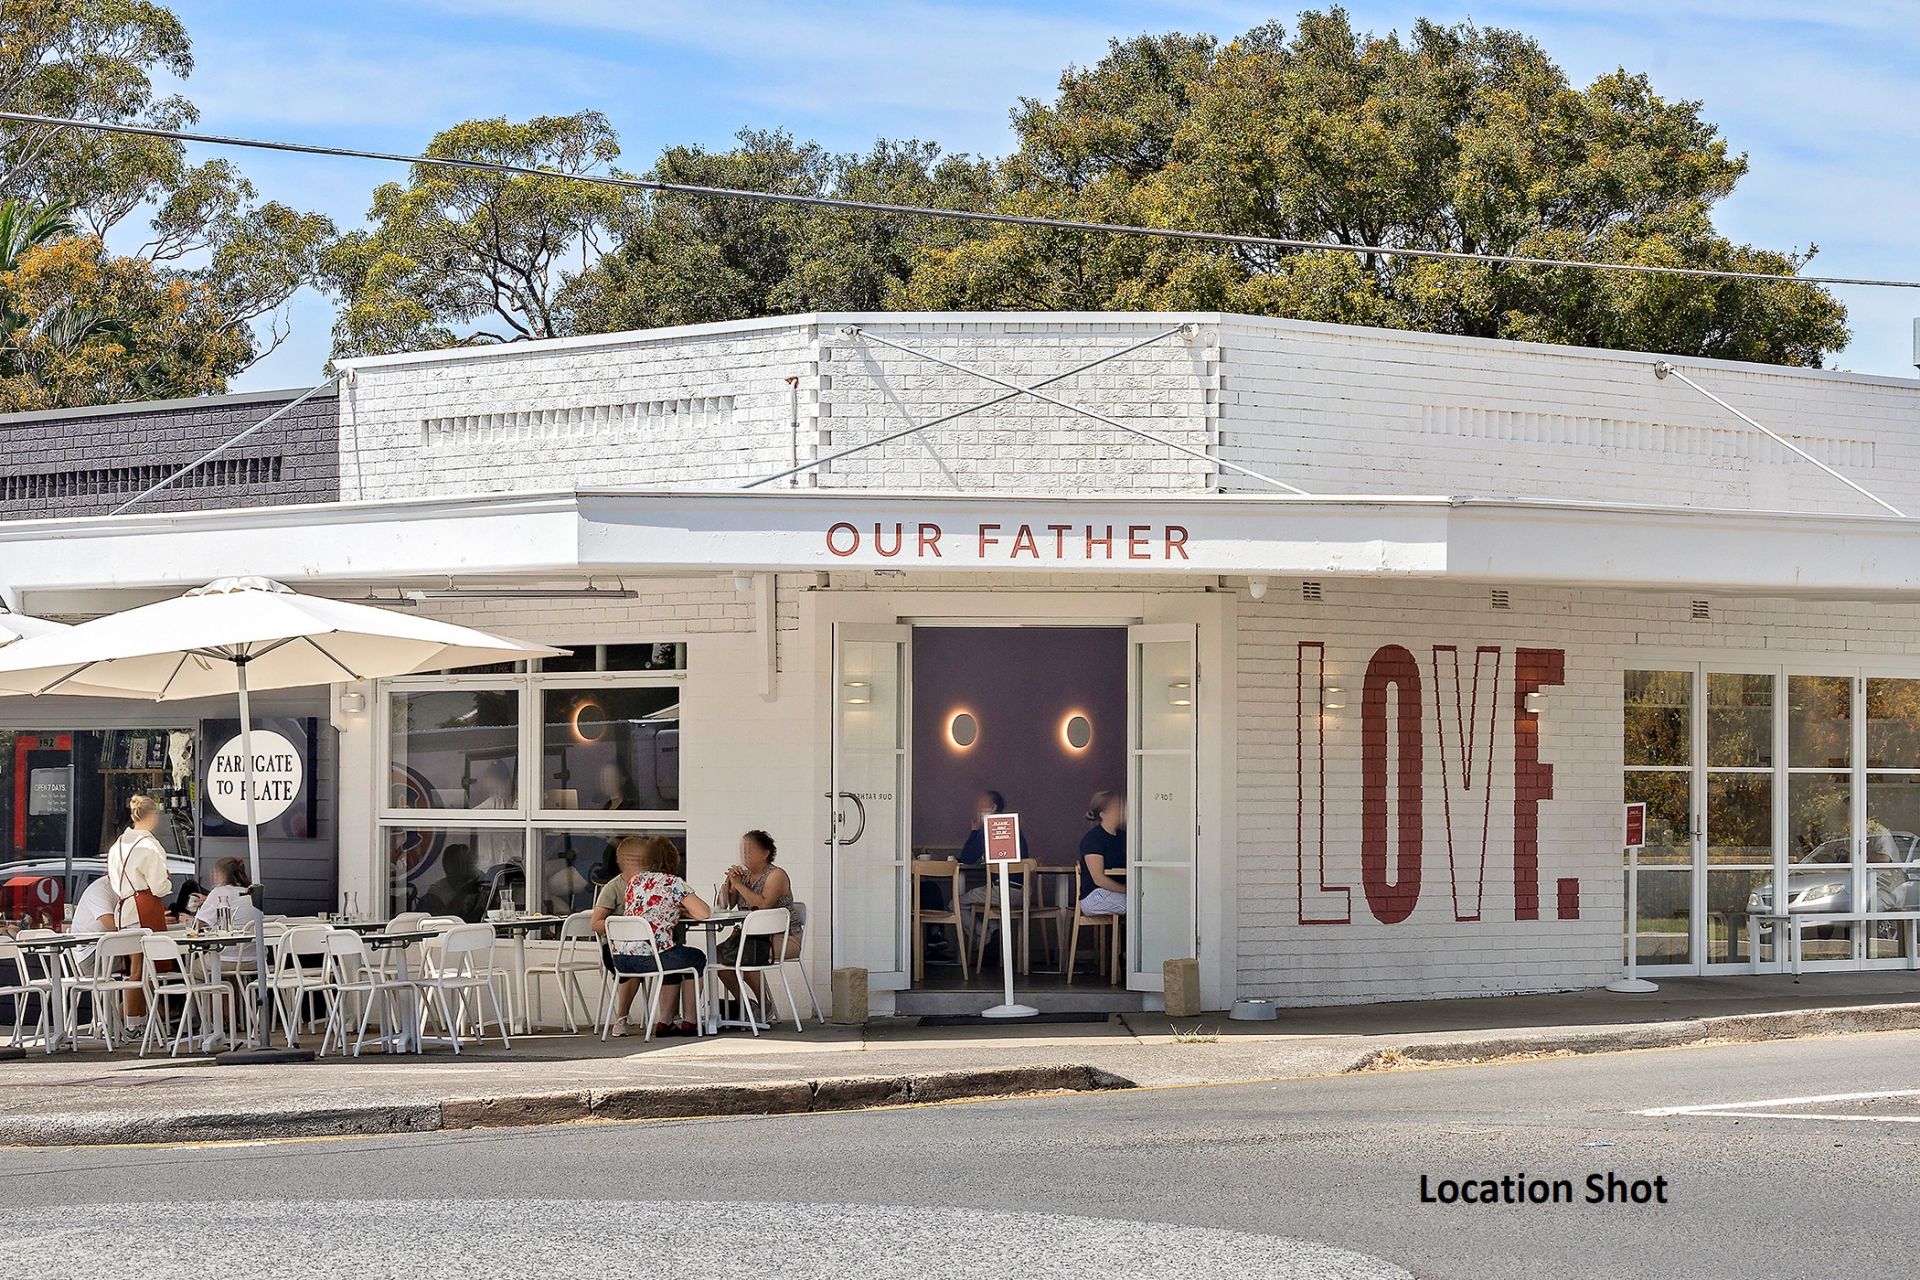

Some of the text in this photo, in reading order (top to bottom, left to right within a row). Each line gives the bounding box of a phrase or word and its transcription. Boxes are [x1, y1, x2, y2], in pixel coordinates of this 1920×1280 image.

[826, 522, 1189, 560] OUR FATHER
[34, 784, 47, 792] OPEN
[216, 780, 233, 795] TO
